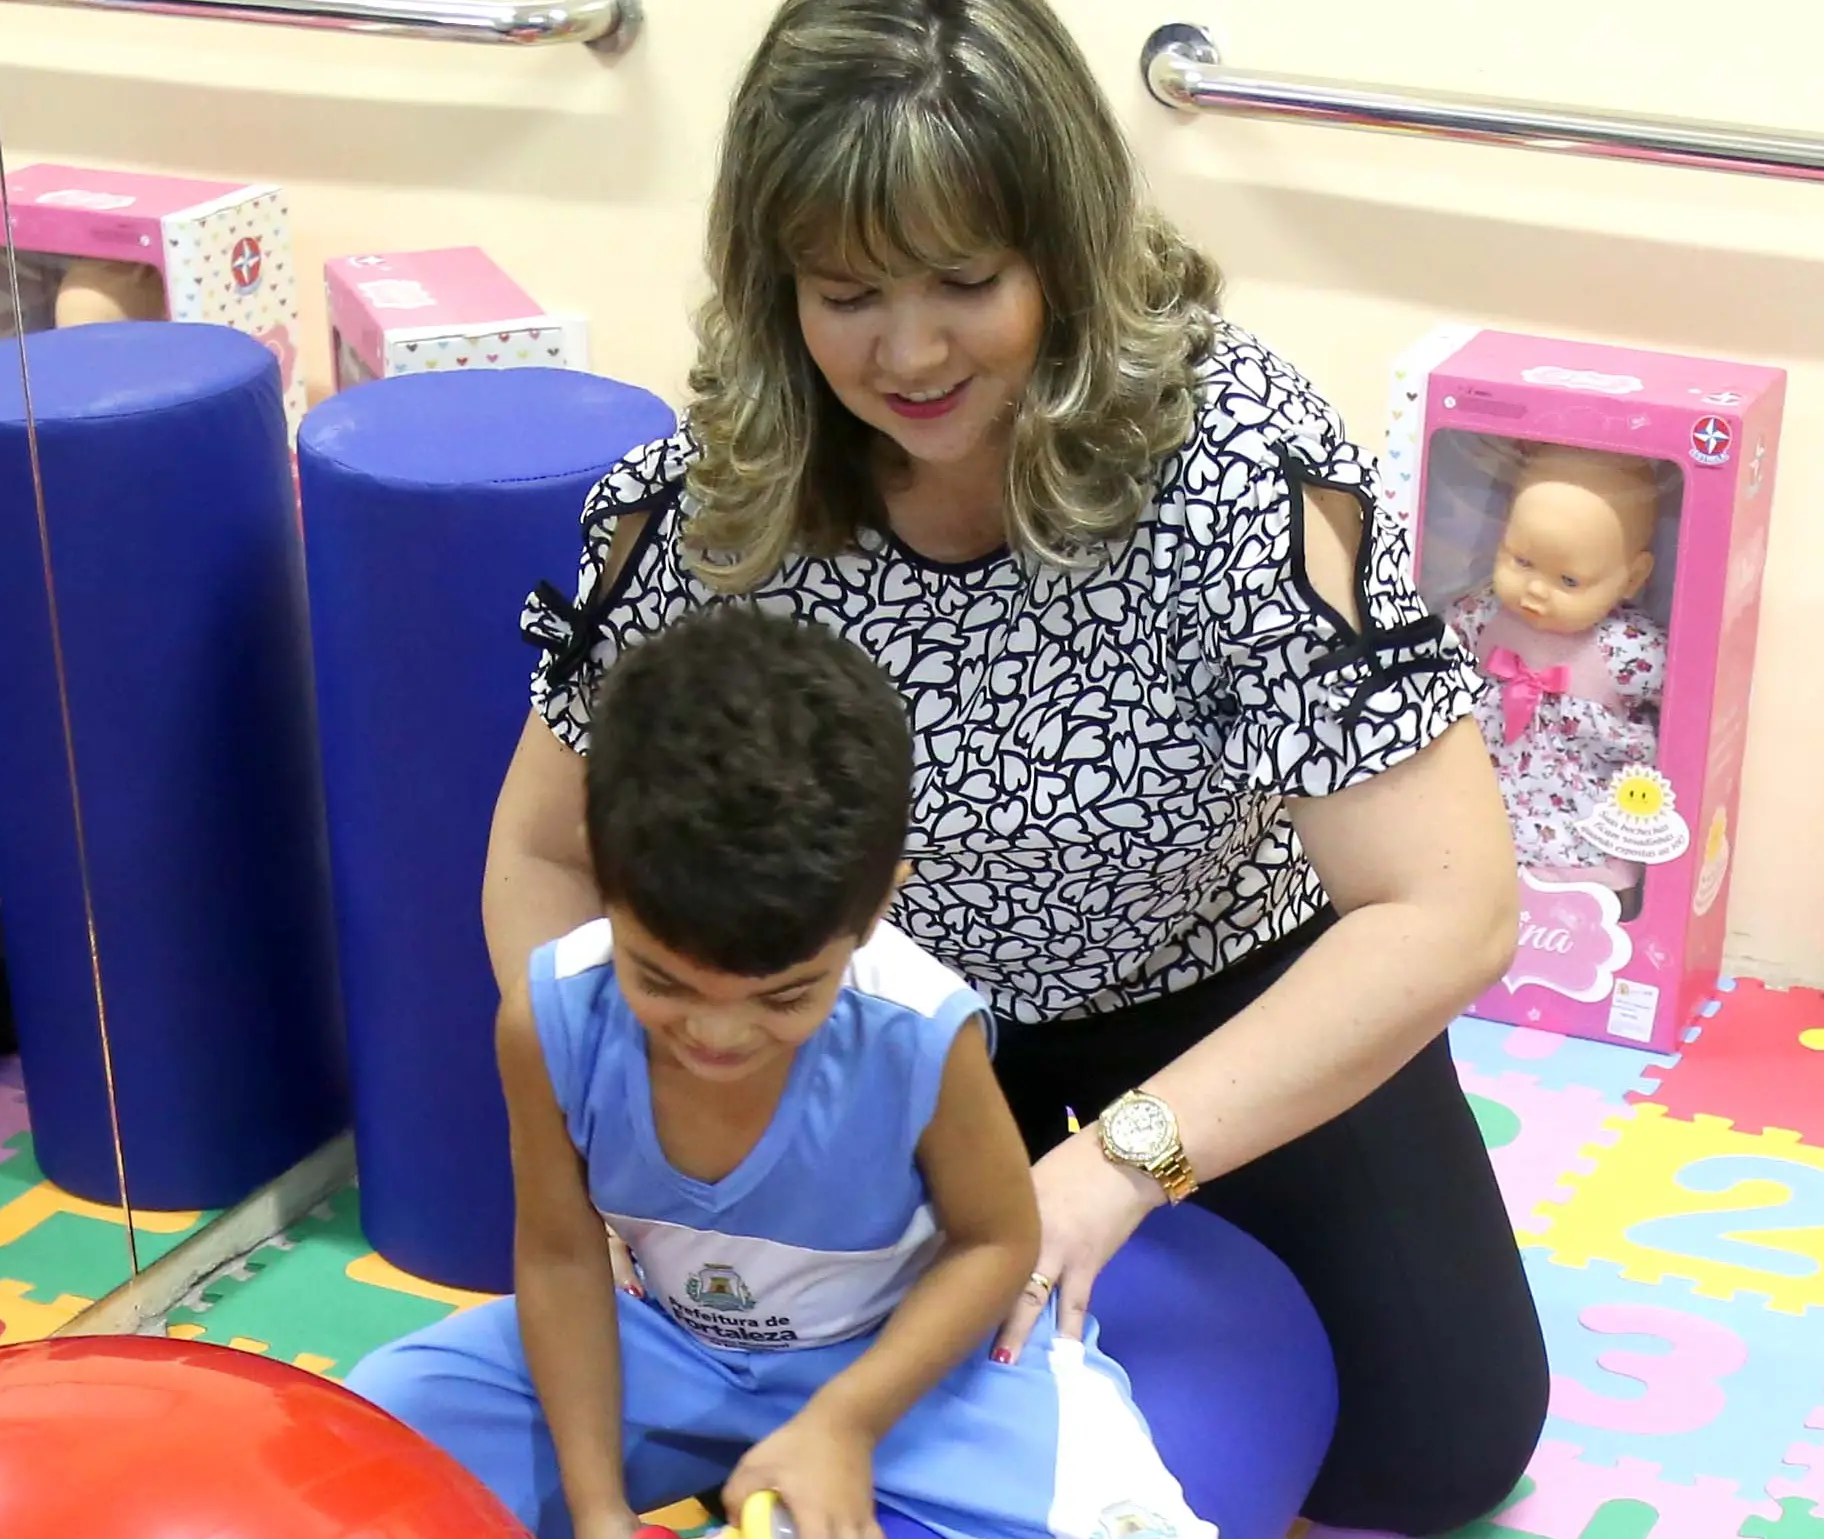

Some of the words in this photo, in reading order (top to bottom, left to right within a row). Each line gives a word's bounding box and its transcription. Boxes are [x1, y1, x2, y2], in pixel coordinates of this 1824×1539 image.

[1519, 911, 1575, 954] ina
[765, 1315, 790, 1328] de
[1538, 1303, 1747, 1436] 3
